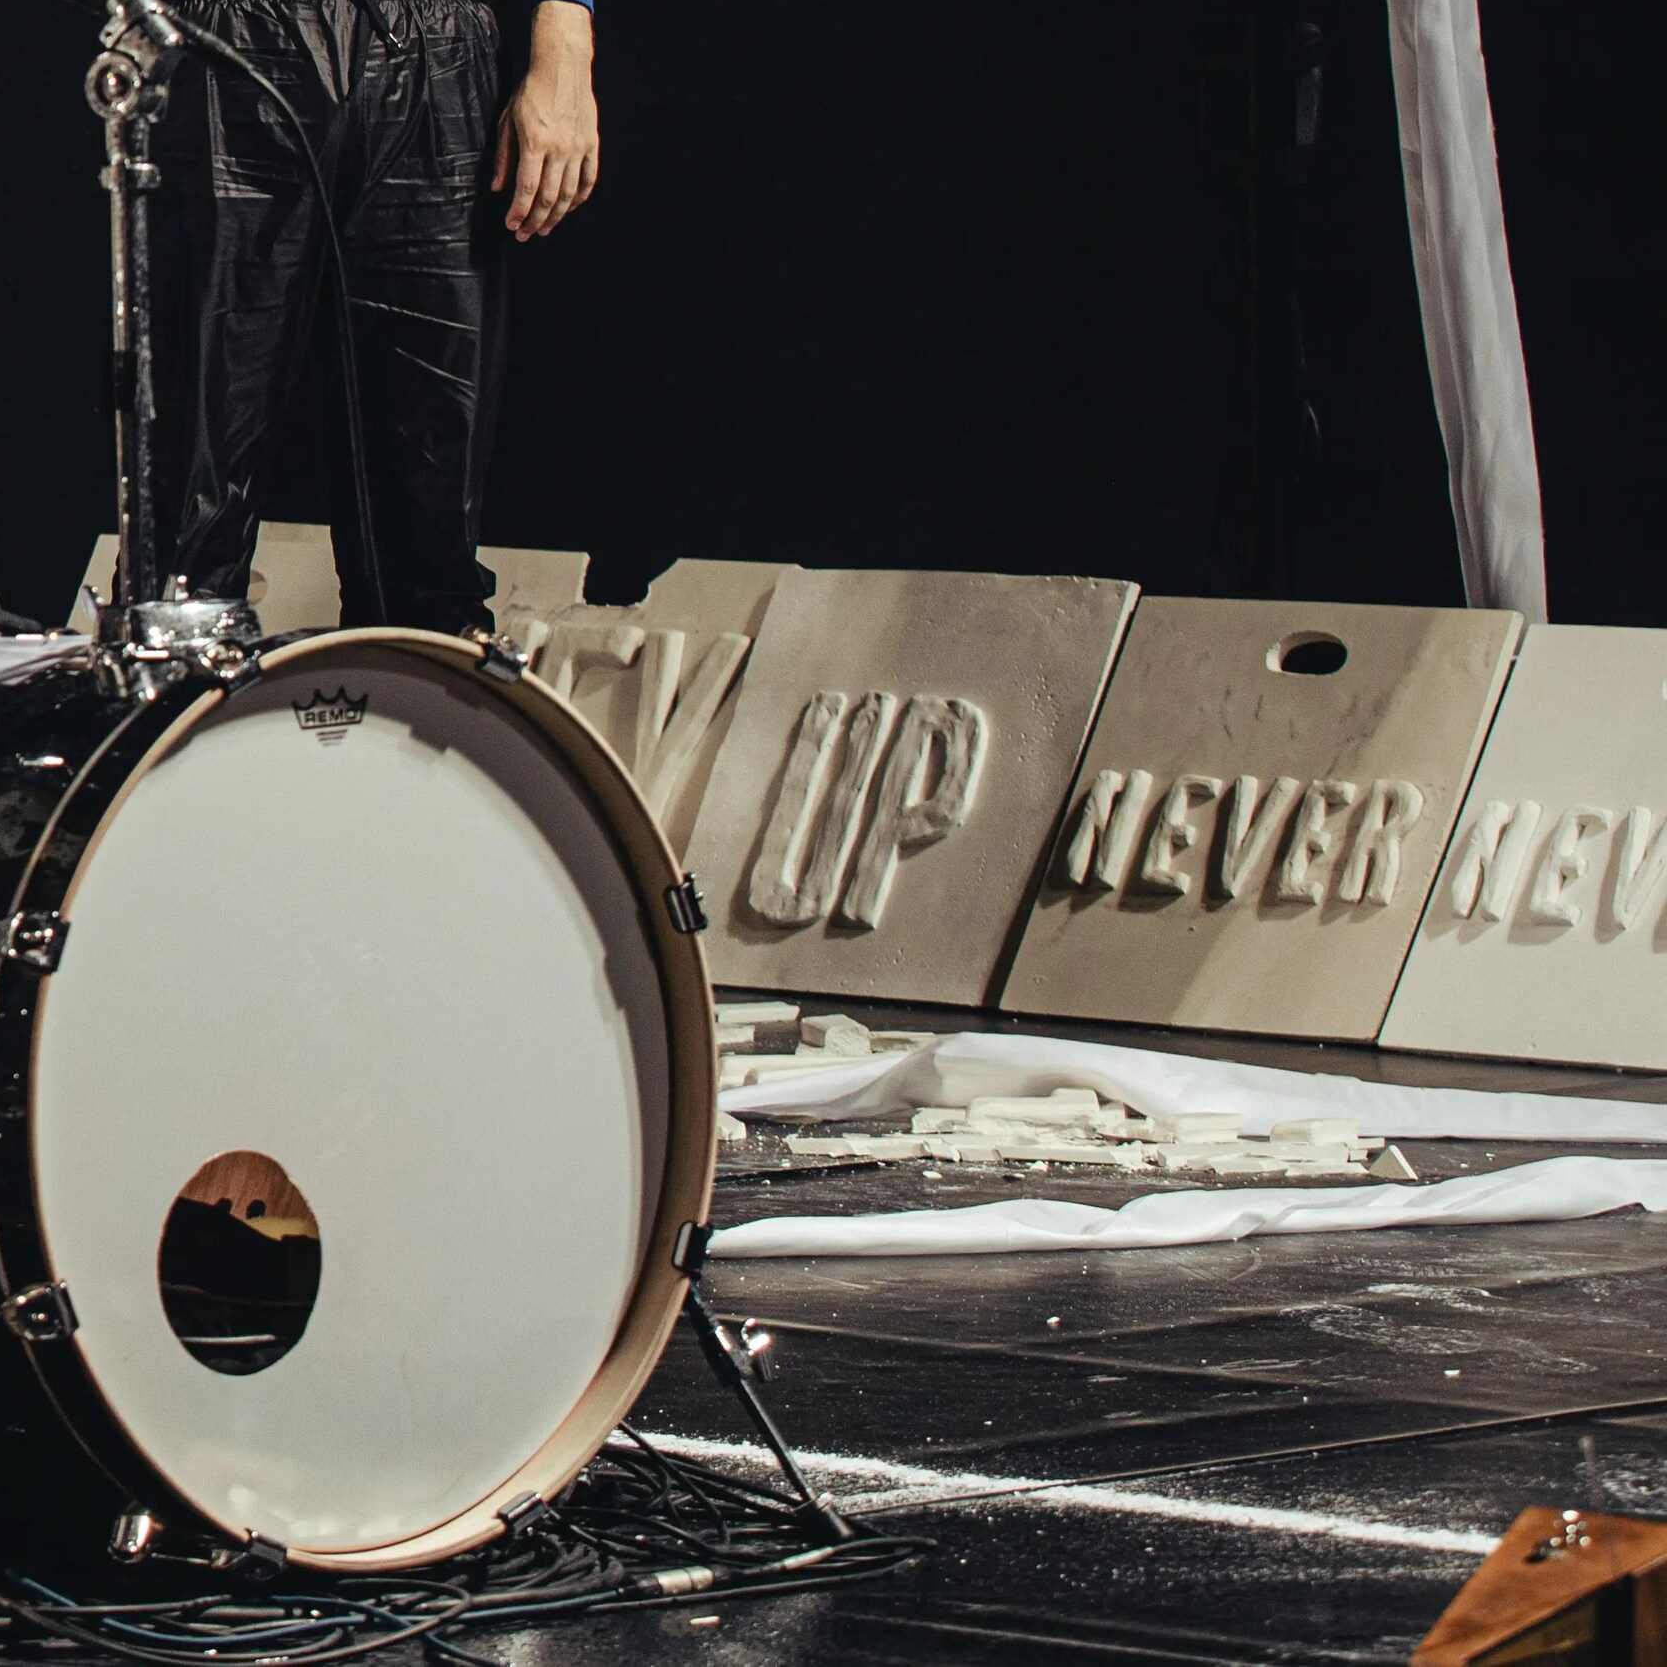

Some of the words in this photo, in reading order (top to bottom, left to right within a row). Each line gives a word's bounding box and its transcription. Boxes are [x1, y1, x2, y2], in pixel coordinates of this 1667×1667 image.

[303, 707, 357, 723] REMO
[747, 691, 989, 930] UP
[1068, 768, 1425, 906] NEVER
